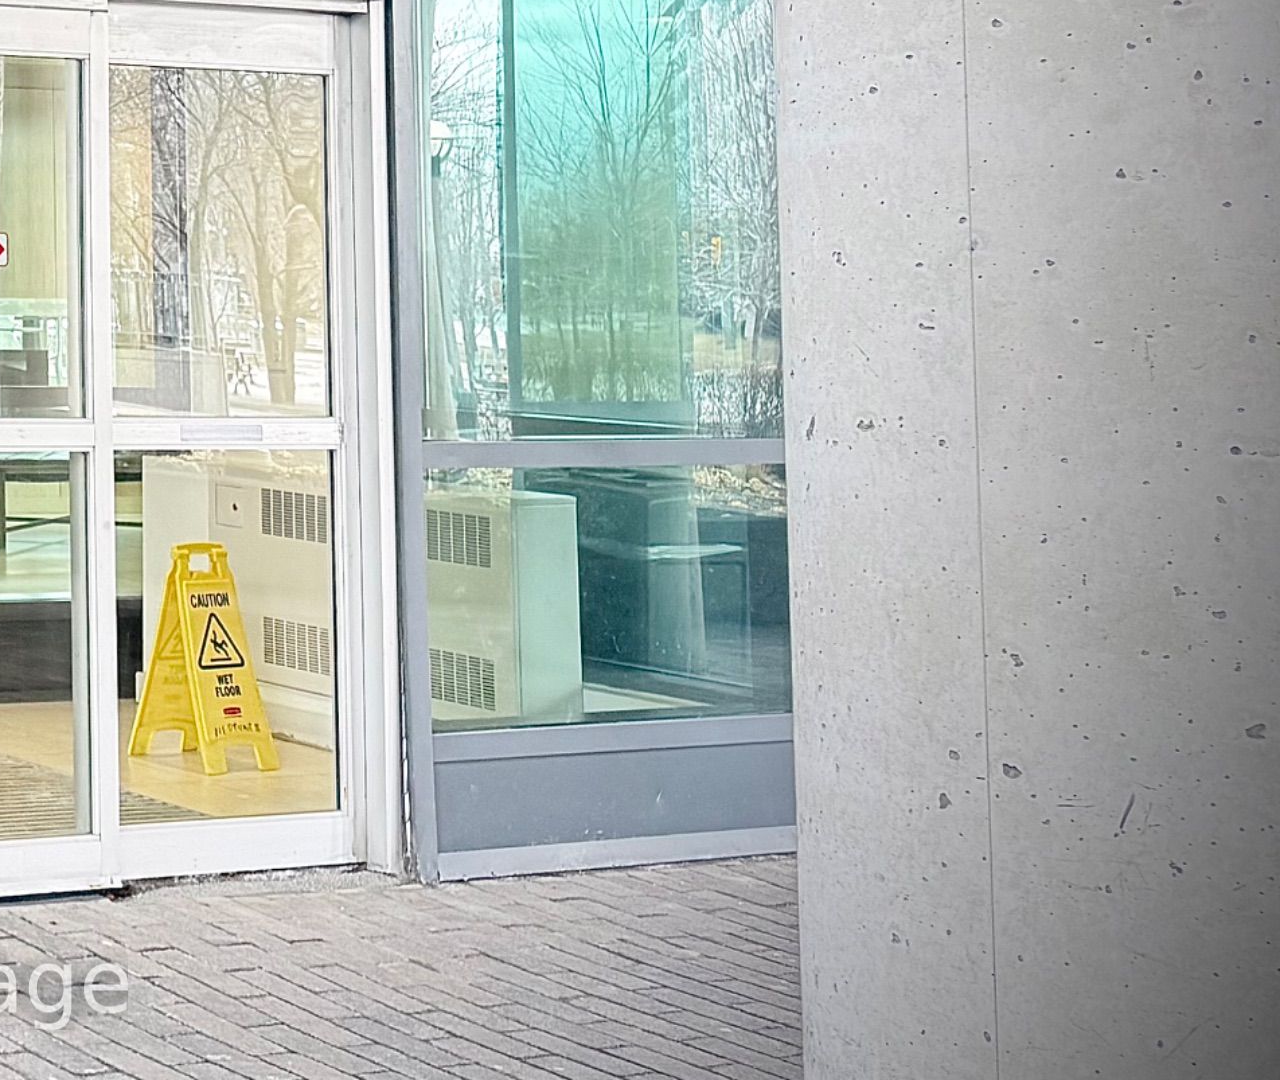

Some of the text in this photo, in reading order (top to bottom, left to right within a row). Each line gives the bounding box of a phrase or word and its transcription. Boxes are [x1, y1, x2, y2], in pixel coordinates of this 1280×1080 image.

[190, 592, 230, 608] CAUTION
[216, 674, 233, 685] WET
[215, 686, 241, 698] FLOOR
